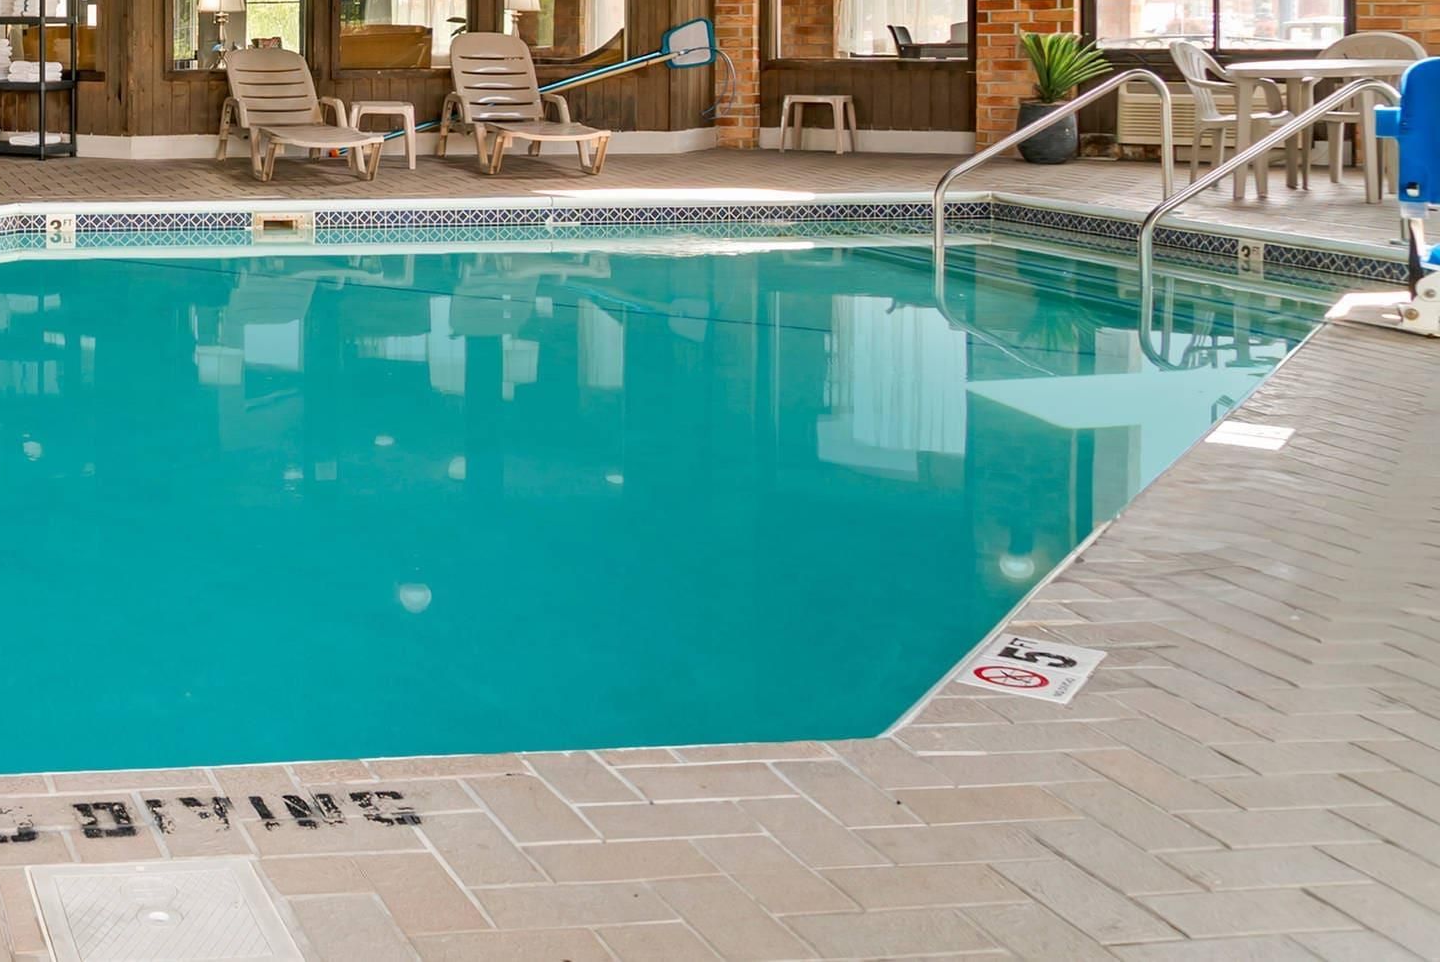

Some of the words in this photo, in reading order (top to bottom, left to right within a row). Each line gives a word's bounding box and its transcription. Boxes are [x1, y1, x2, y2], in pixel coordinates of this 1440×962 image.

[63, 218, 73, 227] FT
[1009, 638, 1038, 649] FT
[997, 647, 1077, 668] 5
